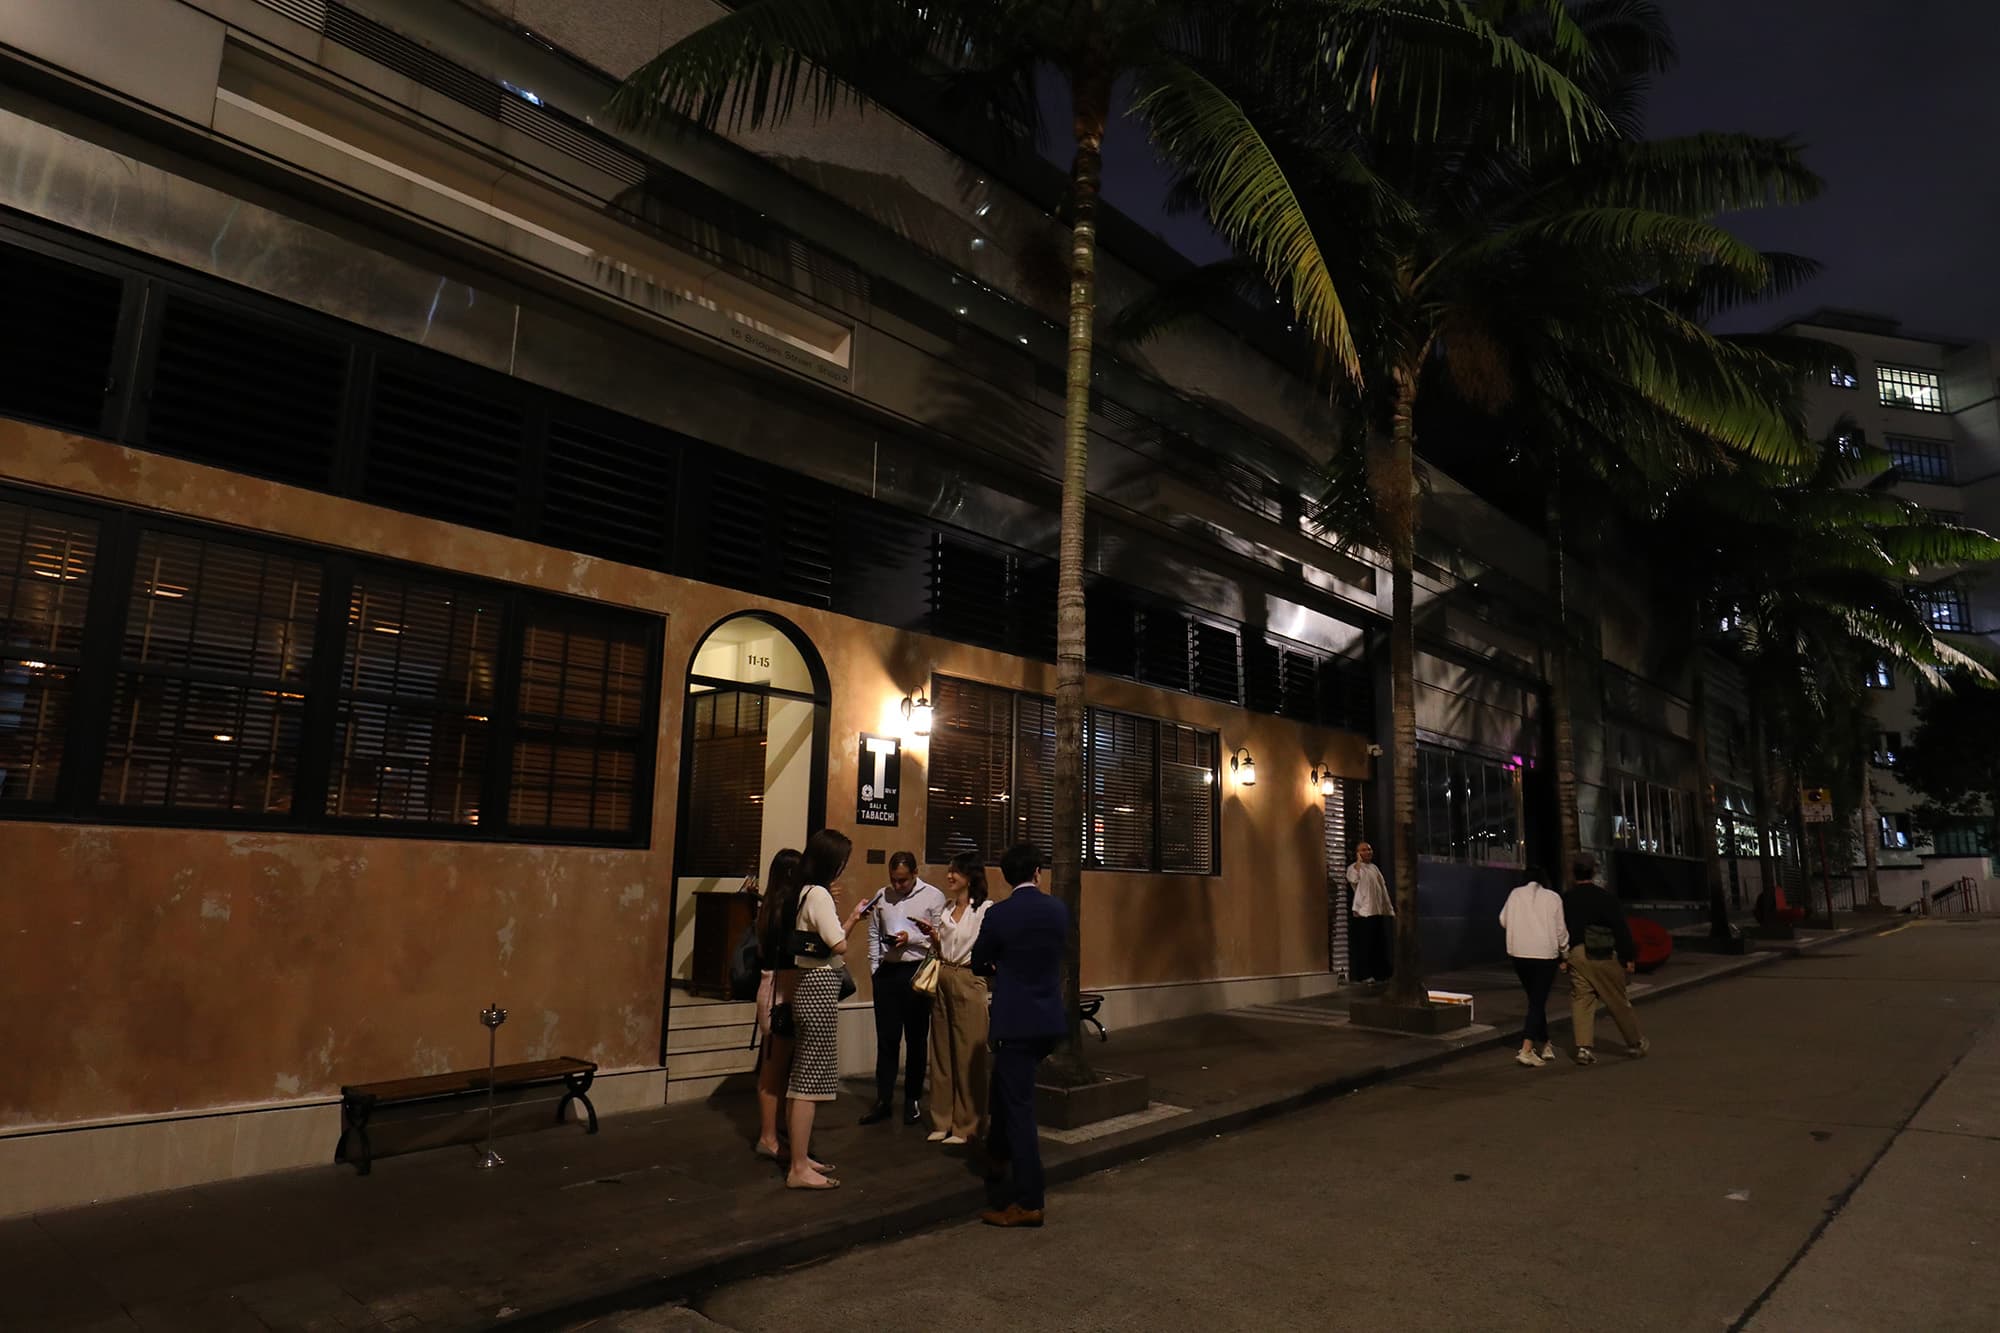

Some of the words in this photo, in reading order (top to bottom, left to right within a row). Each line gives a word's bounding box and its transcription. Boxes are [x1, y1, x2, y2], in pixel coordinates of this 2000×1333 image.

[784, 350, 812, 368] Street
[748, 654, 770, 668] 11-15
[866, 738, 896, 799] T
[861, 809, 895, 821] TABACCHI
